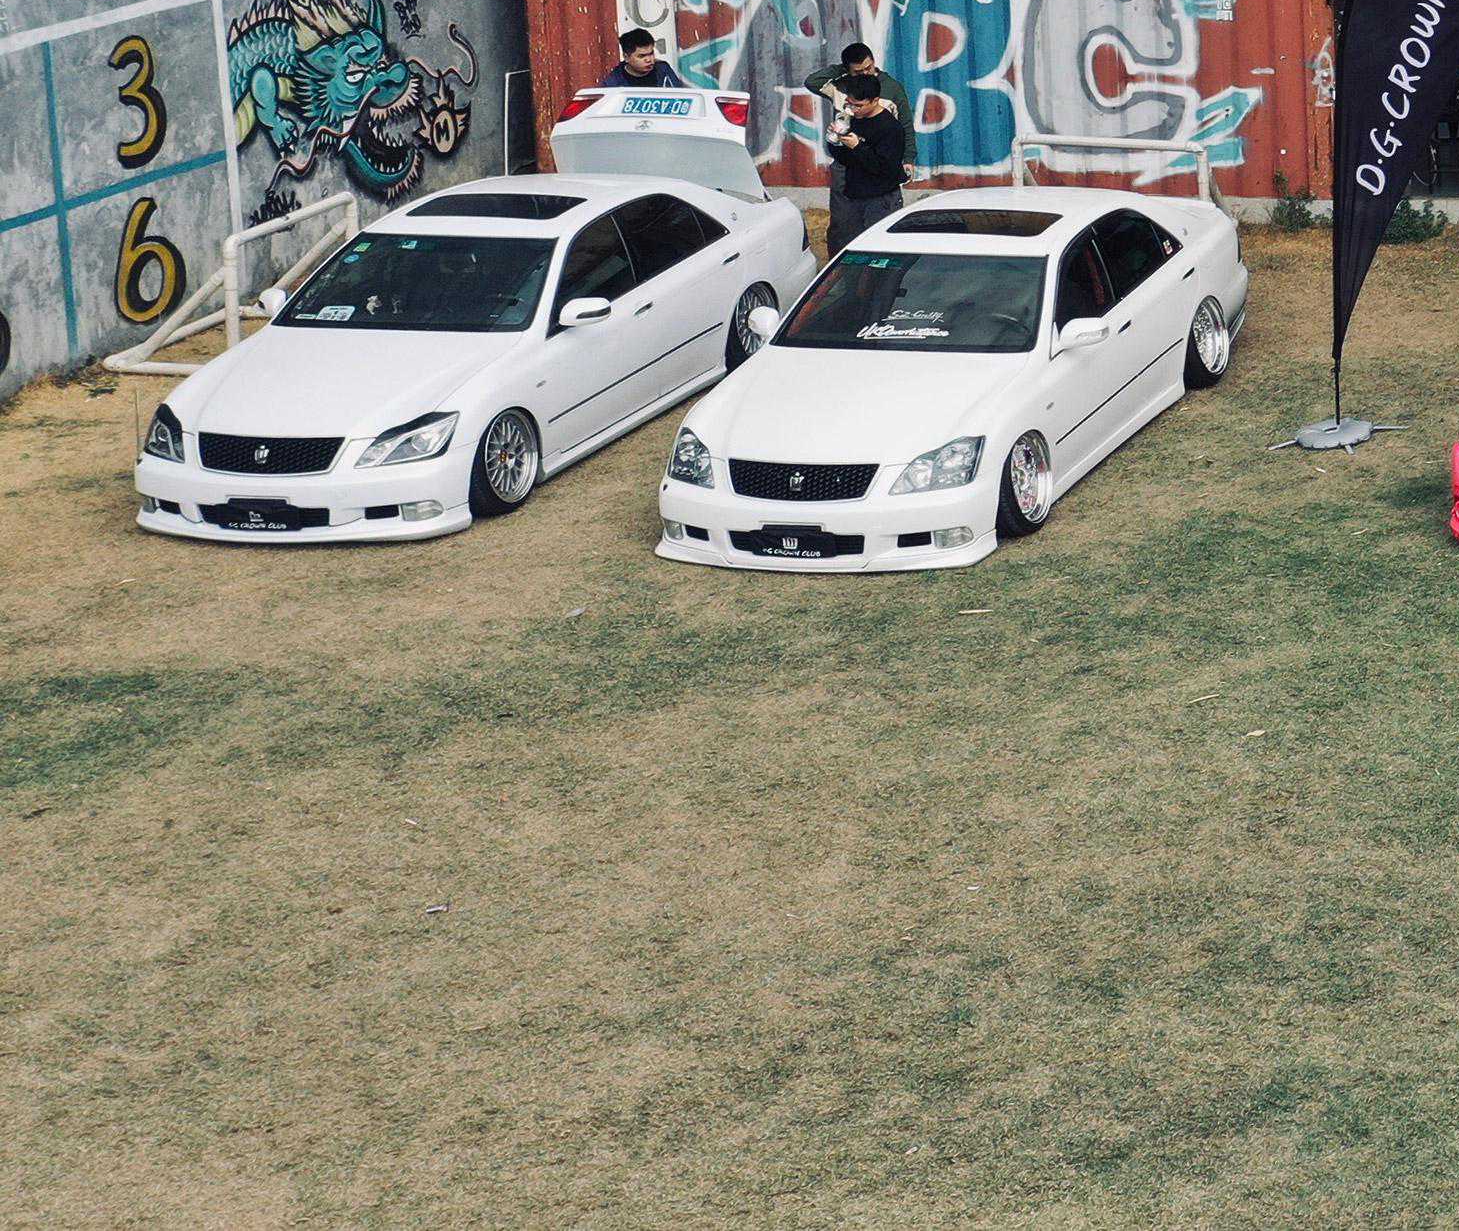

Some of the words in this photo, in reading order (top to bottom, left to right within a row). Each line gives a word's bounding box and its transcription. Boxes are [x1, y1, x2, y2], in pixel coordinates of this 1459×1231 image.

[107, 34, 168, 170] 3
[436, 118, 451, 144] M
[113, 196, 188, 325] 6
